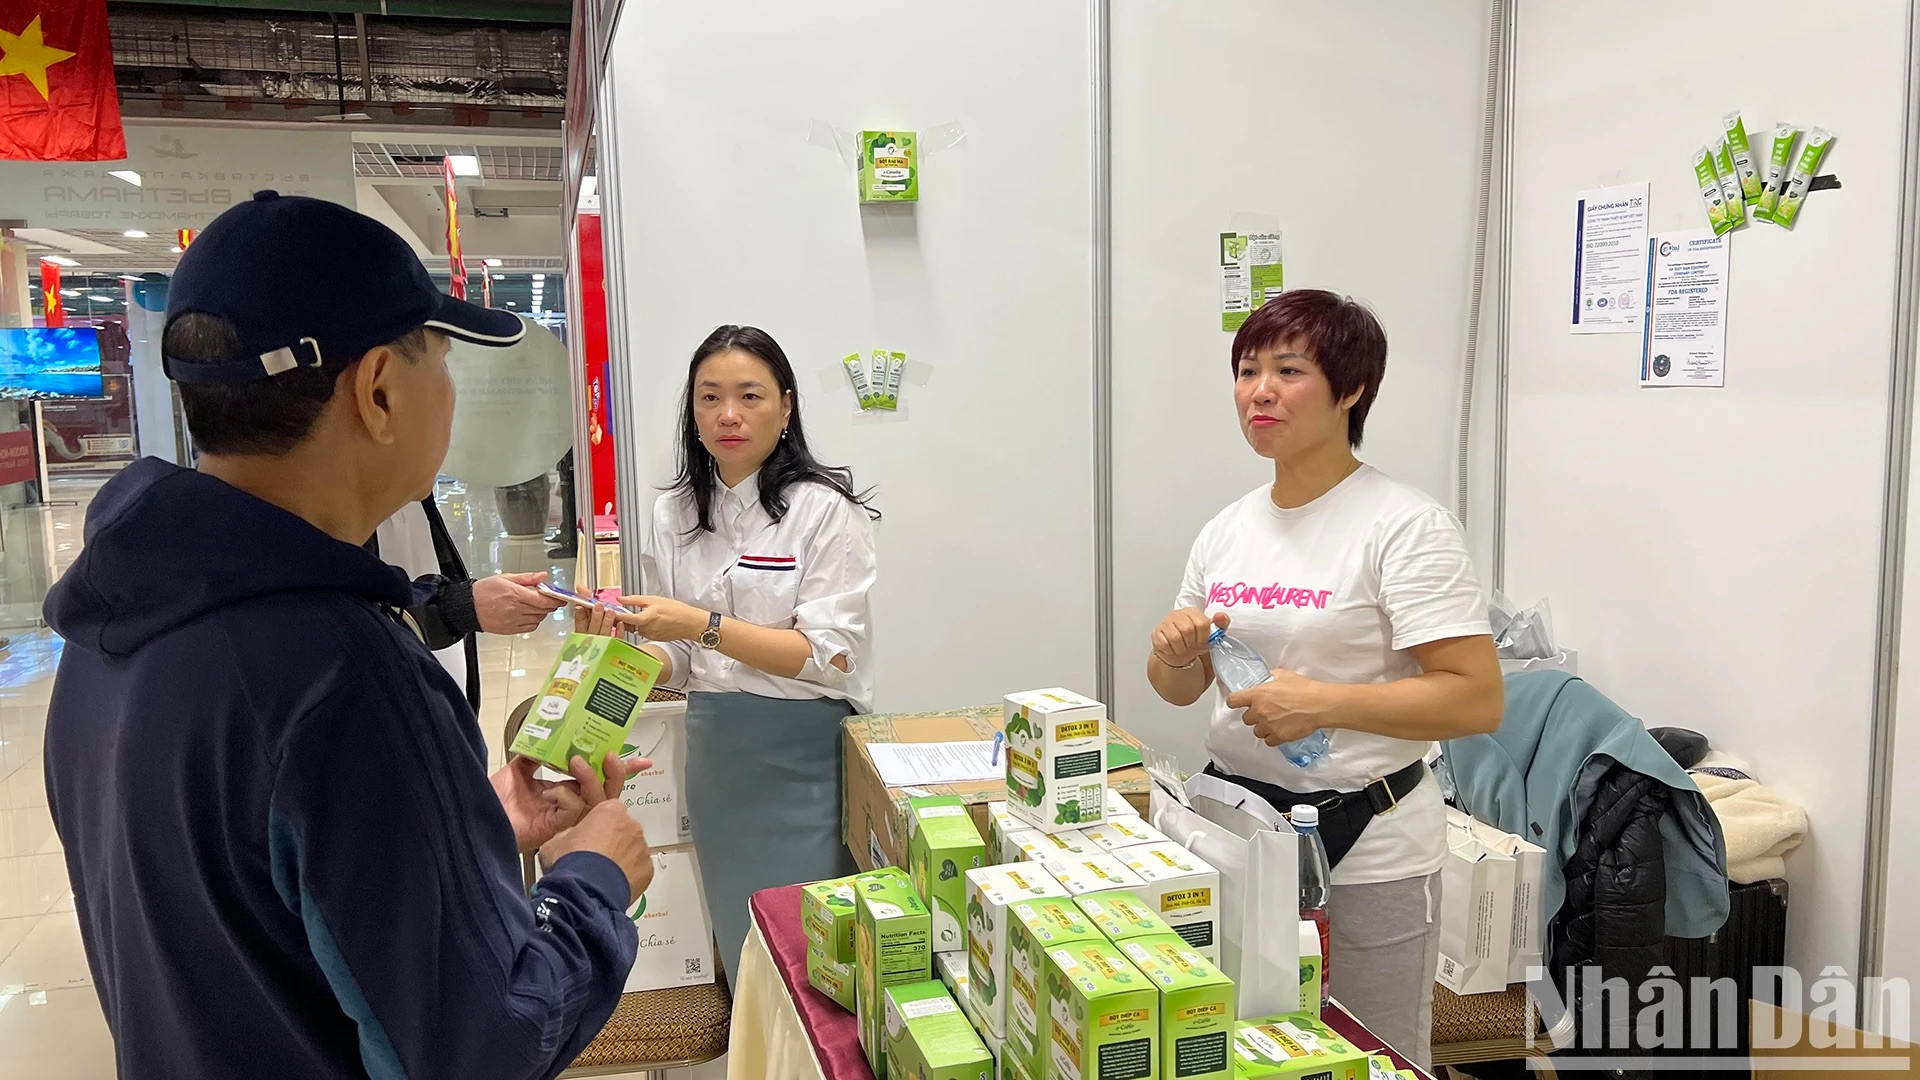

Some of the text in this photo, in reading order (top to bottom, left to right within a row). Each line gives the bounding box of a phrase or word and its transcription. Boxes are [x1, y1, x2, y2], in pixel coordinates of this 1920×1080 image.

[1689, 238, 1722, 246] CERTIFICATE
[636, 792, 660, 806] Chia
[1166, 894, 1186, 902] DETOX
[640, 934, 664, 948] Chia
